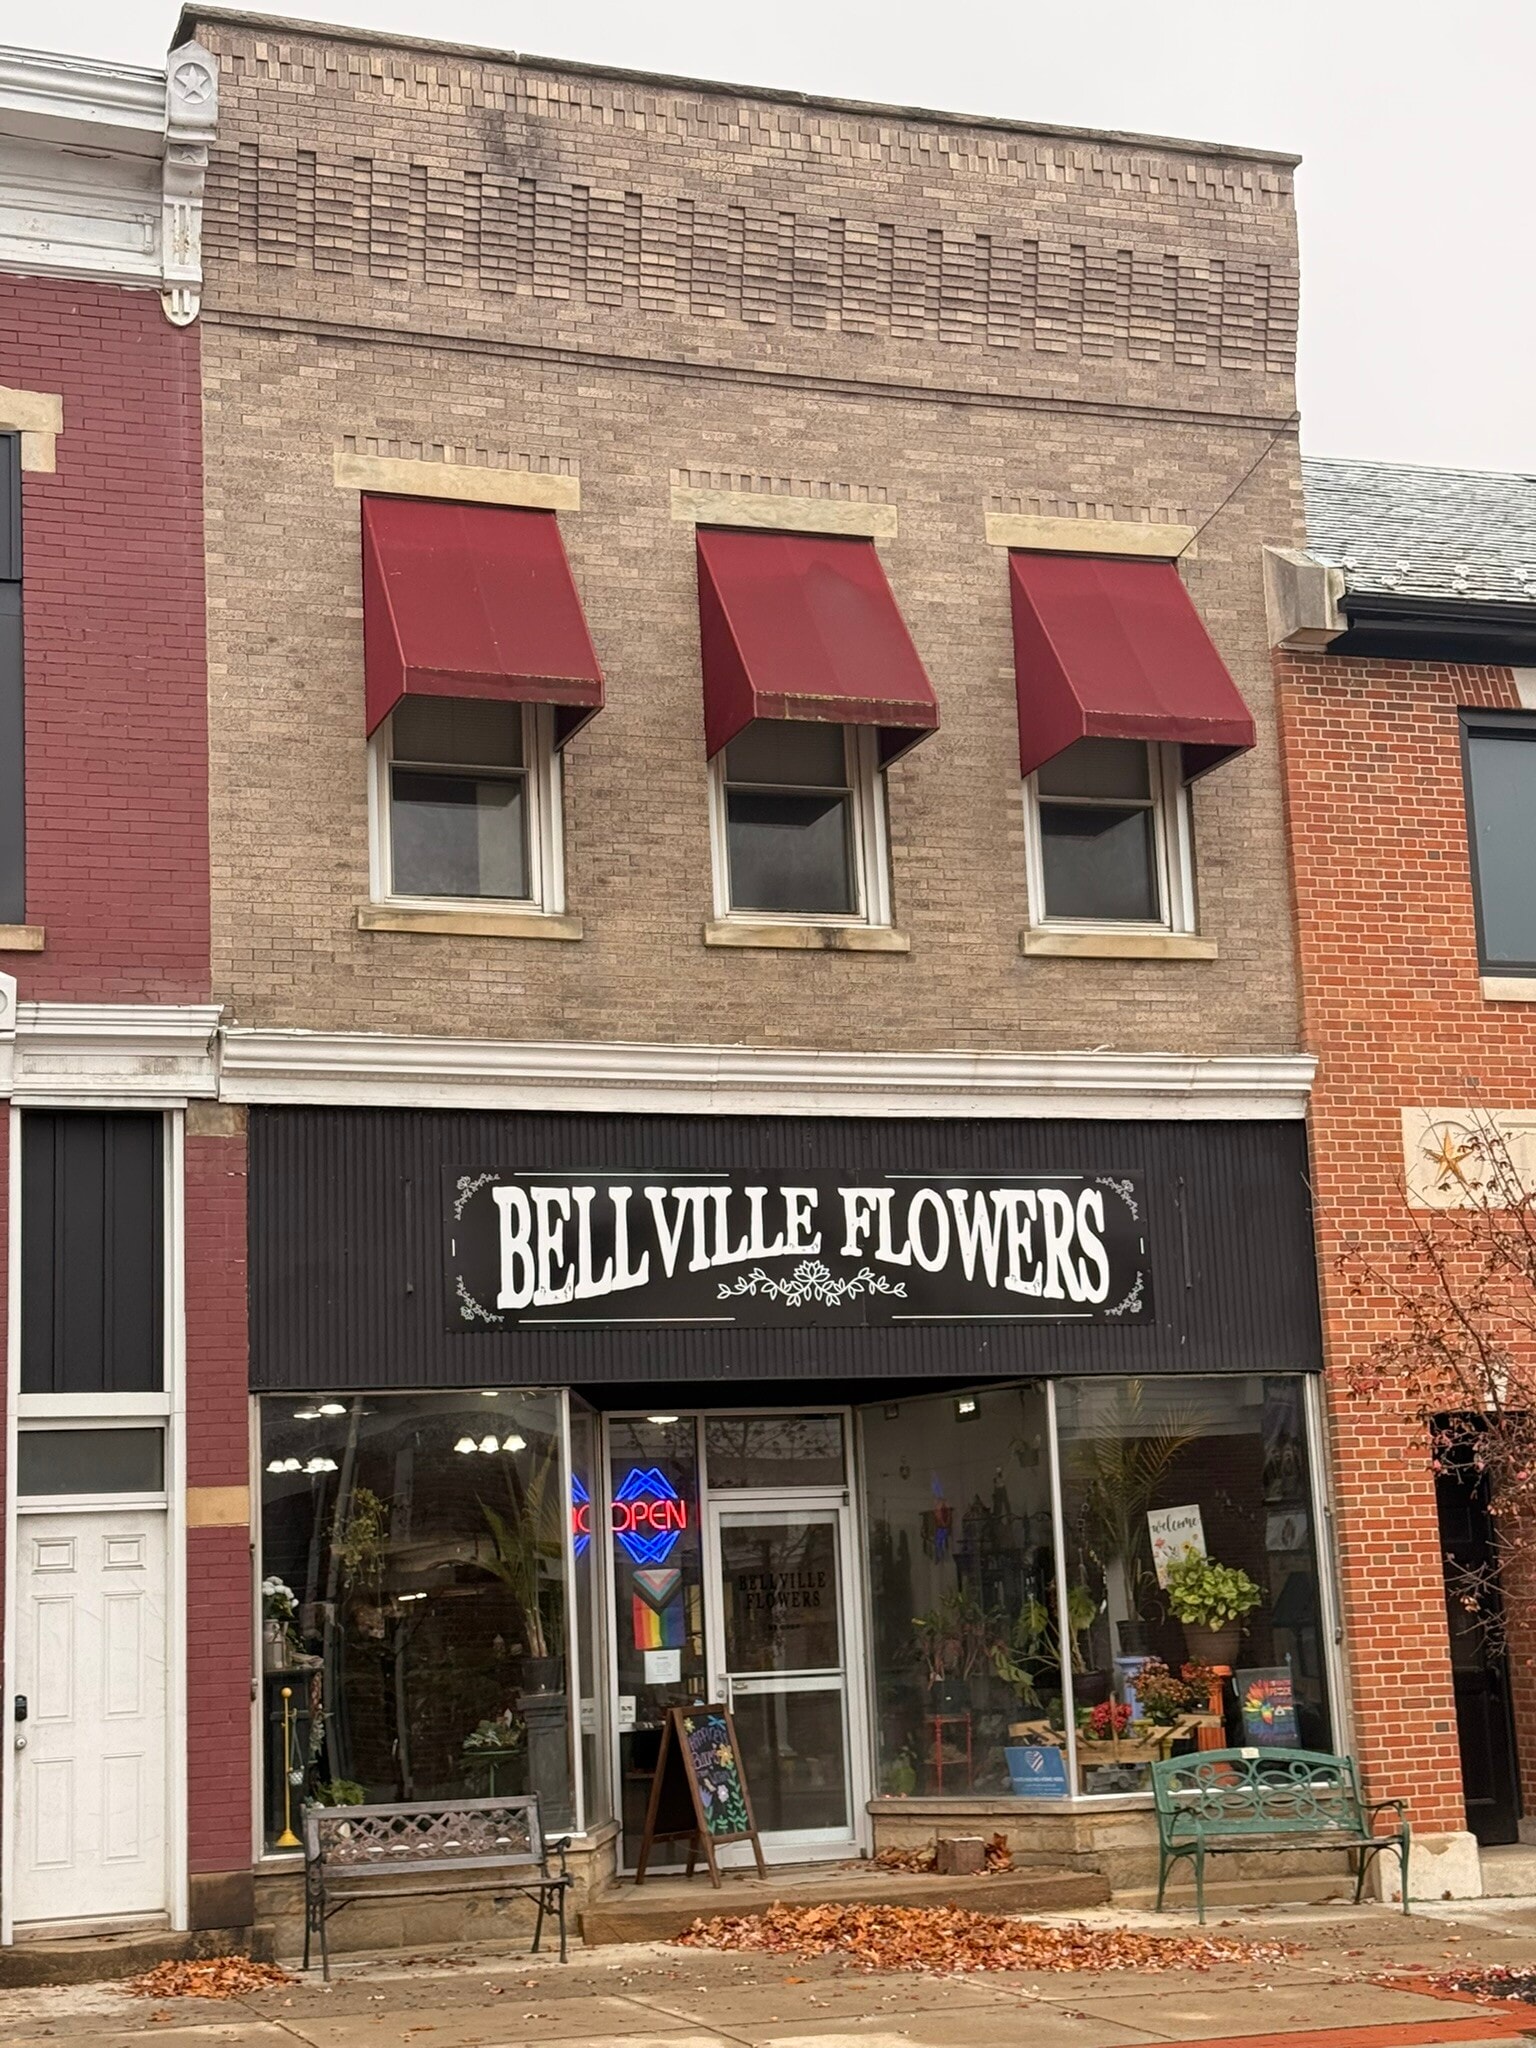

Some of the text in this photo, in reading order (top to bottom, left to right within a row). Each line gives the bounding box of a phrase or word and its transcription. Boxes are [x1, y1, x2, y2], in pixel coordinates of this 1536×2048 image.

[492, 1186, 1110, 1310] BELLVILLE FLOWERS
[611, 1499, 687, 1532] OPEN
[1151, 1514, 1198, 1534] welcome
[738, 1571, 826, 1591] BELLVILLE
[746, 1590, 820, 1610] FLOWERS
